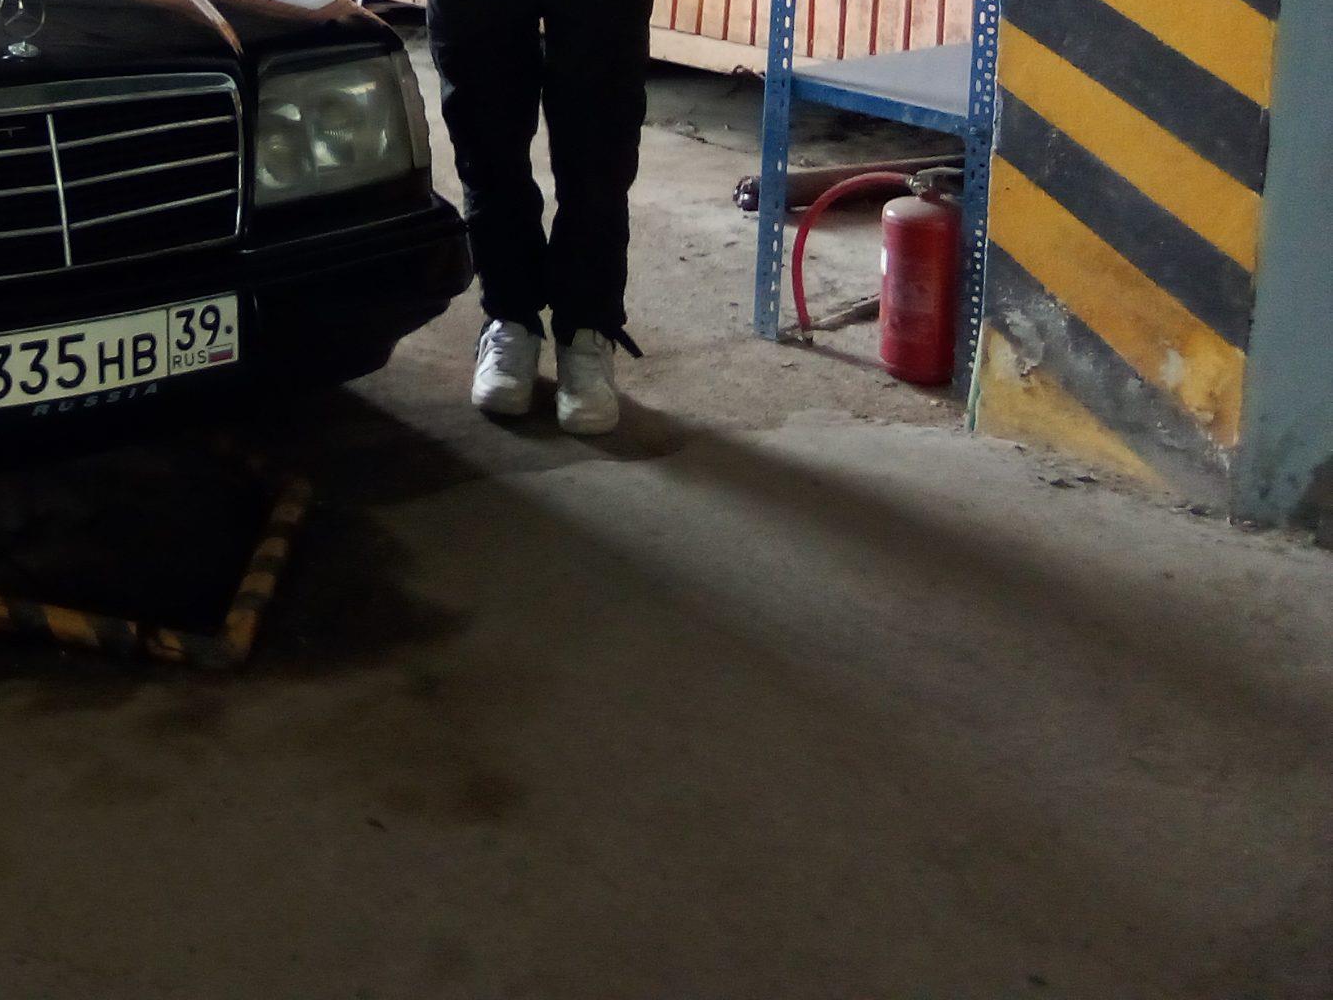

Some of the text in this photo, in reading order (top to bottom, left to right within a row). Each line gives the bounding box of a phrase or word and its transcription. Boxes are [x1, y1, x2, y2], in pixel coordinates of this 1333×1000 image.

[174, 304, 221, 352] 39
[172, 349, 207, 370] RUS
[31, 383, 157, 416] RUSSIA
